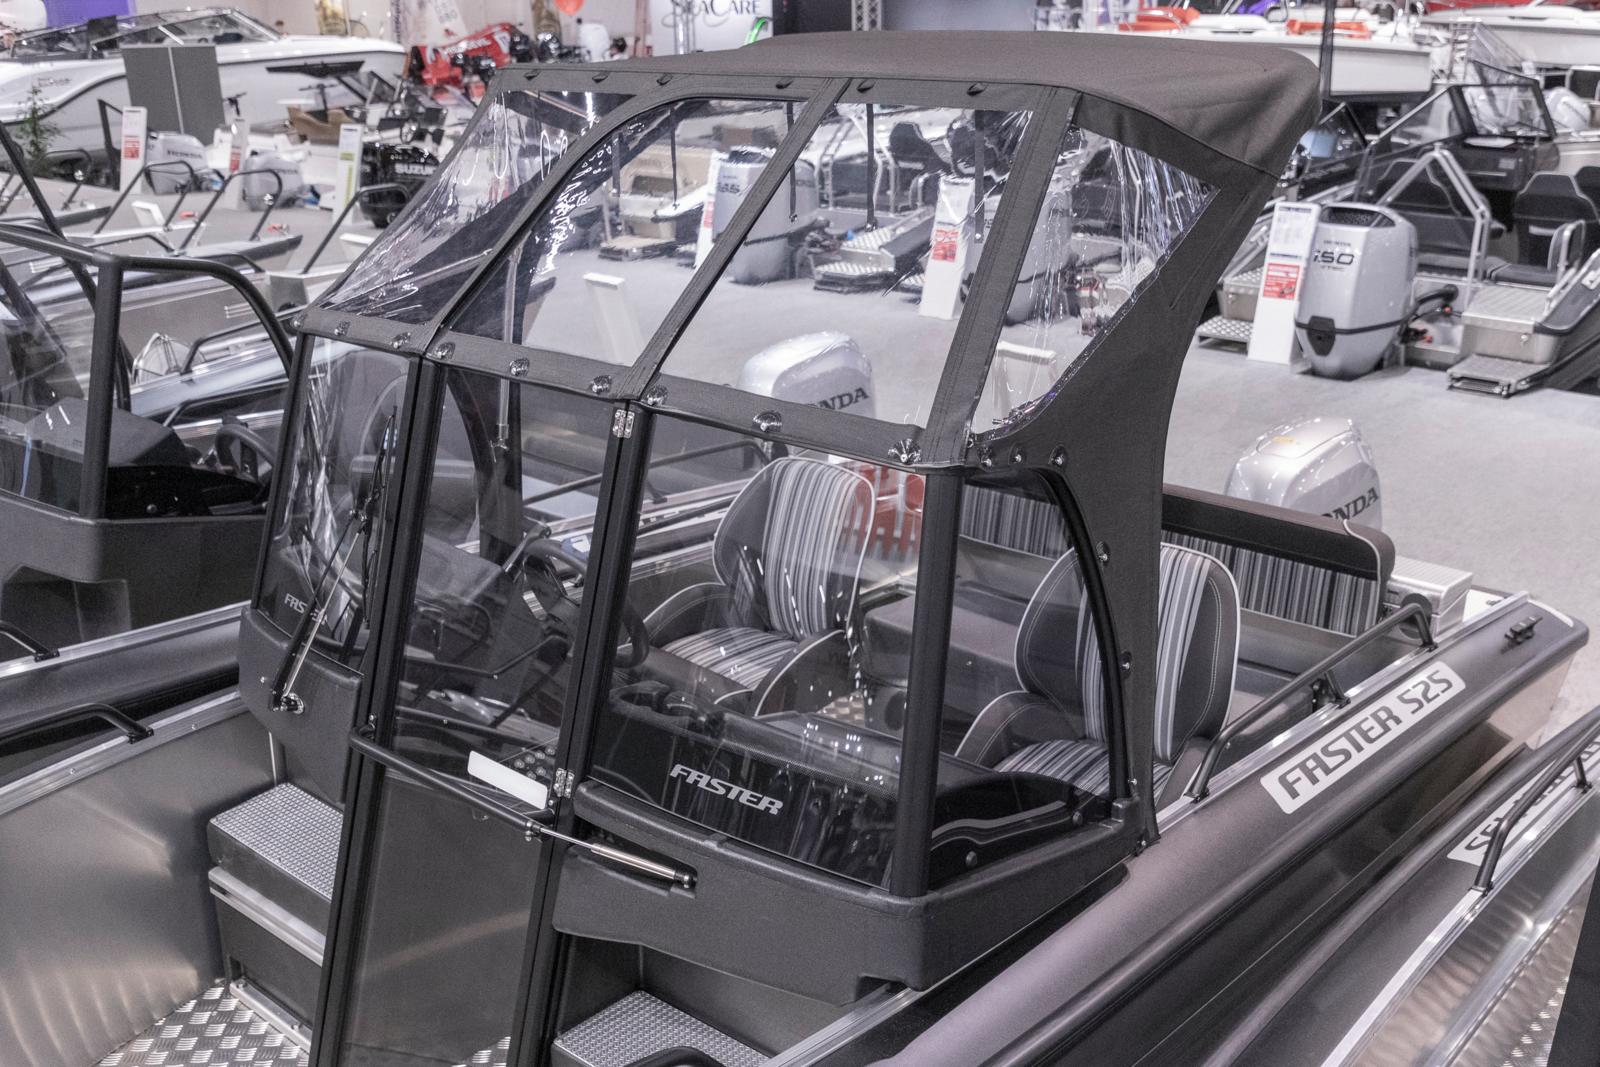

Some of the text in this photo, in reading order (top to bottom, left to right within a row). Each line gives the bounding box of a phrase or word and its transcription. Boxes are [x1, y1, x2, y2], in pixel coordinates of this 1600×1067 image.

[394, 162, 437, 176] SUZUK
[816, 387, 869, 410] NDA
[1321, 487, 1379, 520] NDA
[1277, 669, 1454, 801] FASTER 525
[669, 763, 784, 816] FASTER
